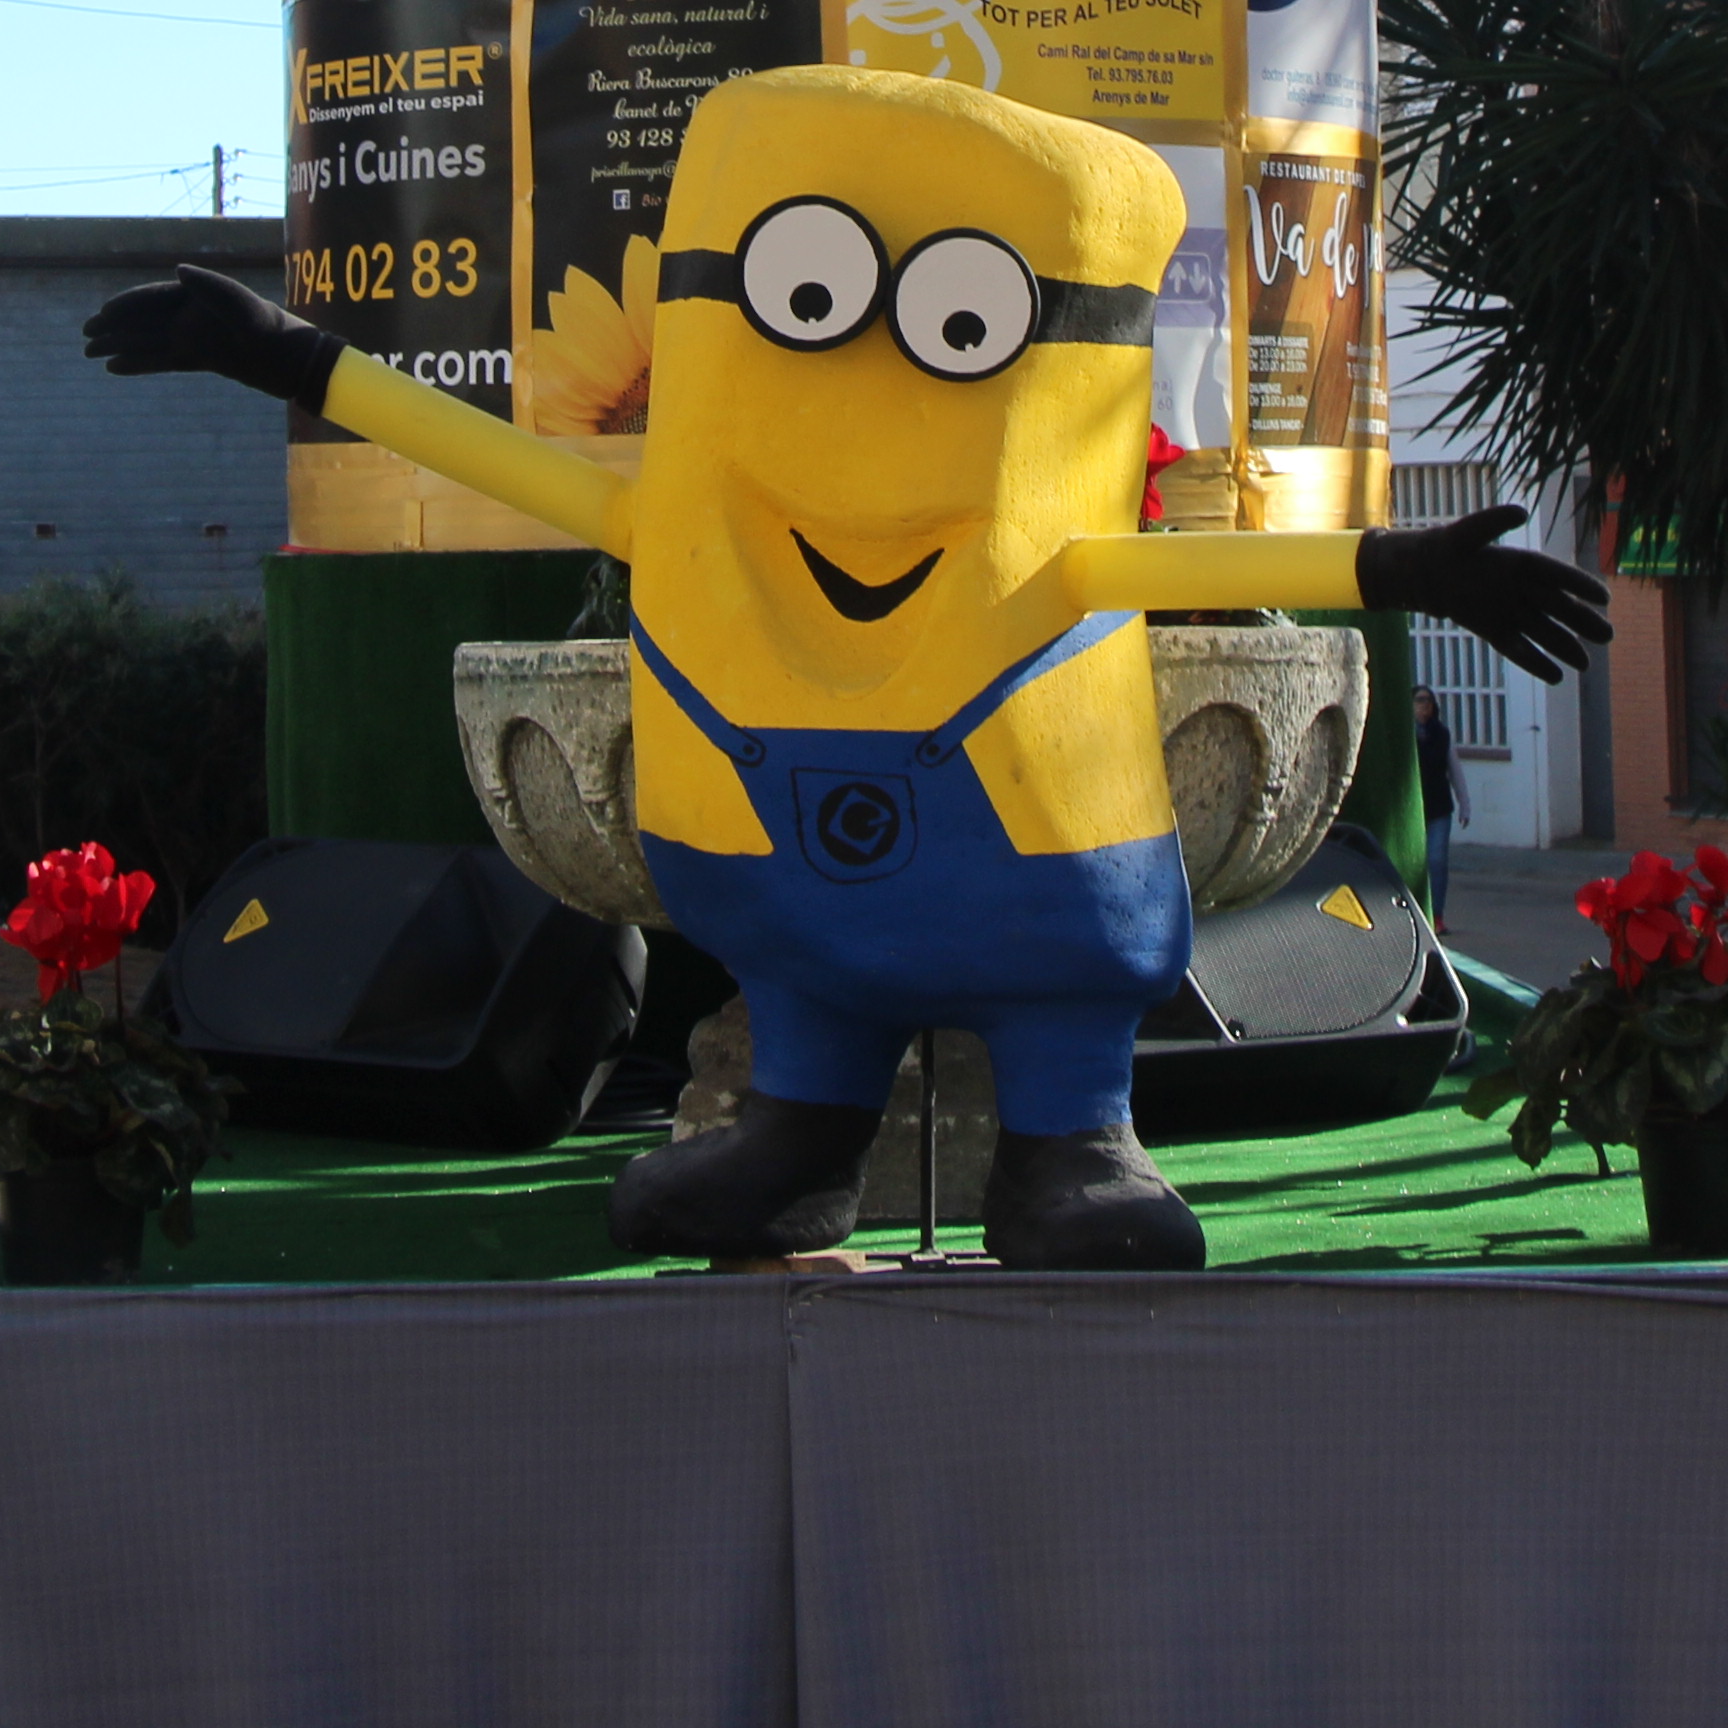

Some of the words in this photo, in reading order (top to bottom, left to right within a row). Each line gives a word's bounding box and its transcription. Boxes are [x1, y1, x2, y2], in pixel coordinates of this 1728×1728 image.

[579, 4, 627, 28] Vida
[629, 10, 680, 25] sana,
[684, 0, 758, 23] natural
[759, 2, 771, 20] i
[1026, 7, 1069, 30] PER
[1073, 3, 1100, 25] AL
[627, 35, 717, 62] ecològica
[1072, 44, 1092, 61] Ral
[1093, 45, 1112, 62] del
[1114, 46, 1147, 67] Camp
[1148, 49, 1163, 64] de
[1163, 52, 1177, 65] sa
[1177, 50, 1198, 66] Mar
[306, 45, 485, 104] FREIXER
[587, 70, 631, 93] Riera
[1087, 66, 1107, 83] Tel.
[1109, 67, 1174, 86] 93.795.76.03
[309, 102, 375, 124] Dissenyem
[379, 96, 394, 115] el
[397, 93, 426, 113] teu
[430, 89, 485, 111] espai
[612, 97, 659, 121] Canet
[663, 97, 683, 118] de
[1091, 88, 1132, 108] Arenys
[1133, 89, 1149, 106] de
[1149, 89, 1171, 106] Mar
[606, 129, 632, 149] 93
[636, 127, 674, 147] 128
[338, 143, 348, 187] i
[355, 135, 487, 184] Cuines
[1260, 160, 1330, 183] RESTAURANT
[1333, 171, 1345, 186] DE
[1244, 184, 1315, 286] Va
[1322, 191, 1359, 300] de
[293, 248, 334, 306] 794
[345, 242, 395, 303] 02
[411, 237, 478, 299] 83
